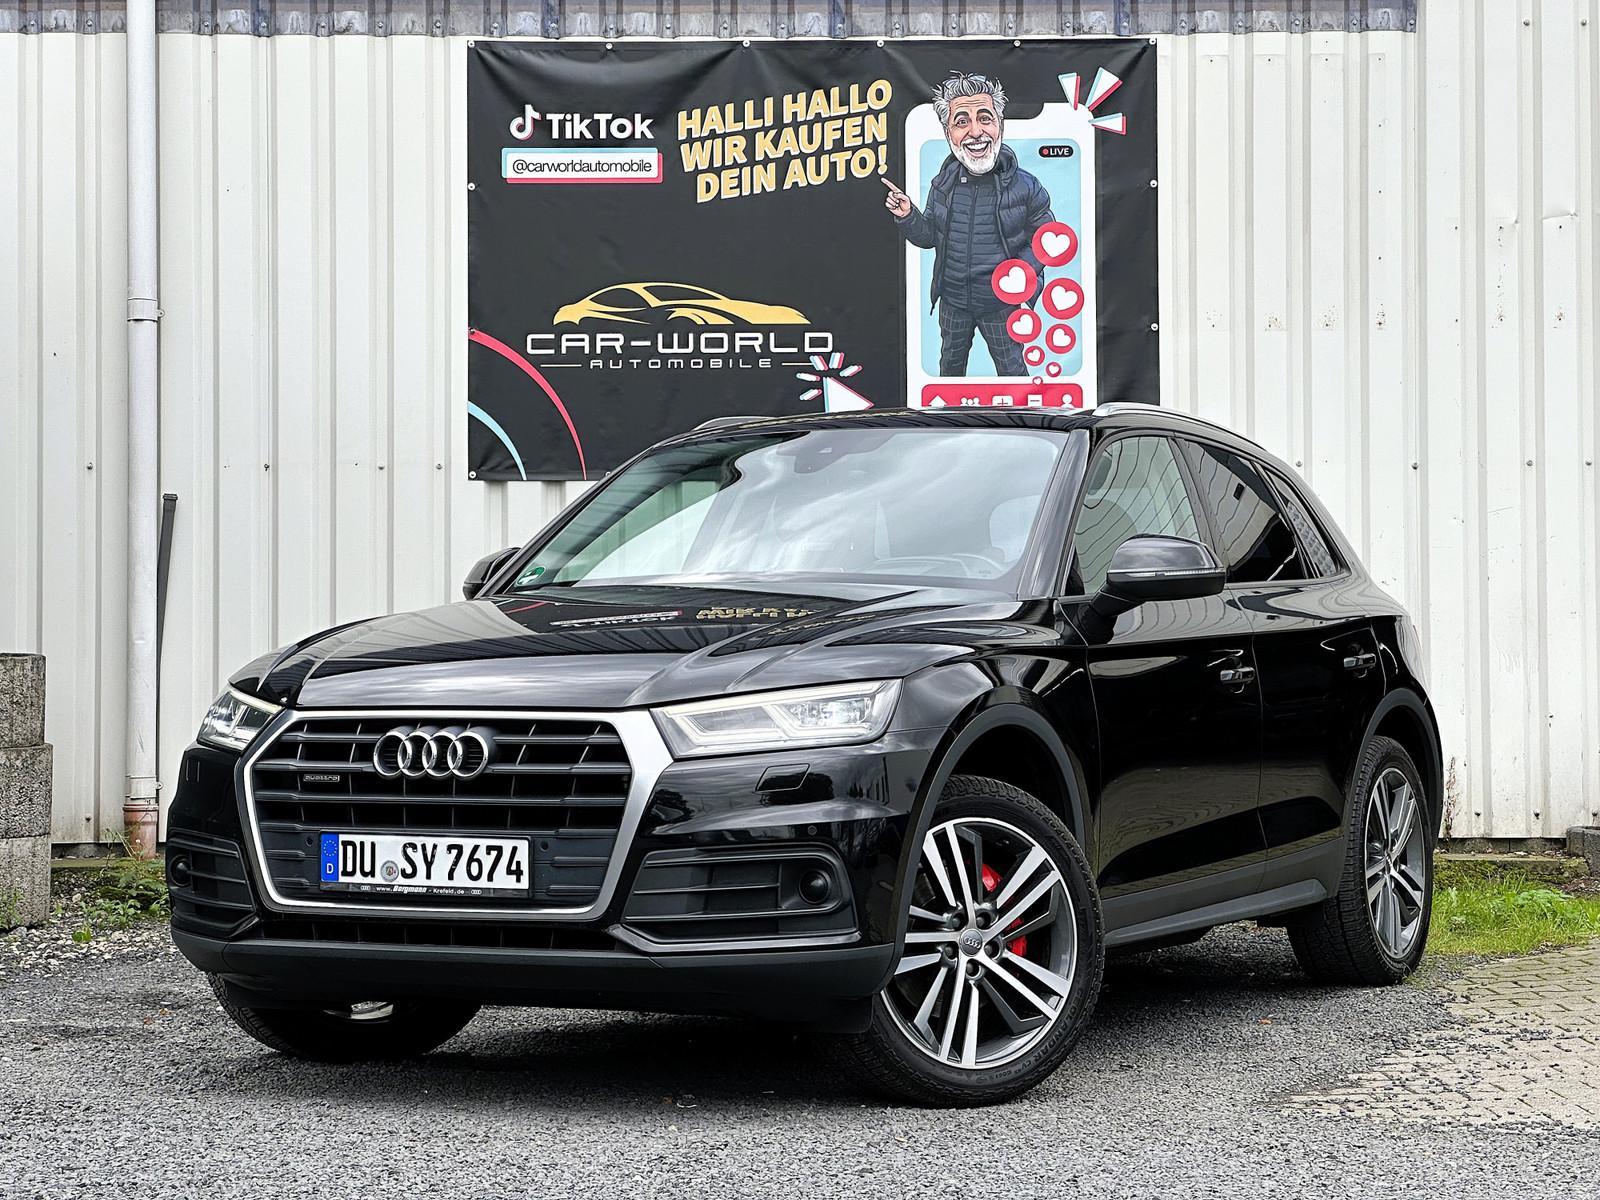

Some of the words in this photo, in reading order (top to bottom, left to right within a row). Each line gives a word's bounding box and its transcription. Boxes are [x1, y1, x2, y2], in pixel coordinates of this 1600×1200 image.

[677, 96, 774, 141] HALLI
[783, 79, 893, 124] HALLO
[546, 113, 655, 139] TikTok
[680, 134, 748, 172] WIR
[755, 112, 888, 161] KAUFEN
[1050, 147, 1069, 155] LIVE
[512, 159, 652, 174] @carworldautomobile
[696, 161, 776, 203] DEIN
[783, 144, 888, 190] AUTO!
[526, 332, 833, 354] CAR-WORLD
[590, 358, 772, 369] AUTOMOBILE
[326, 863, 334, 874] D
[340, 840, 376, 878] DU
[400, 842, 438, 881] SY
[446, 843, 524, 883] 7674
